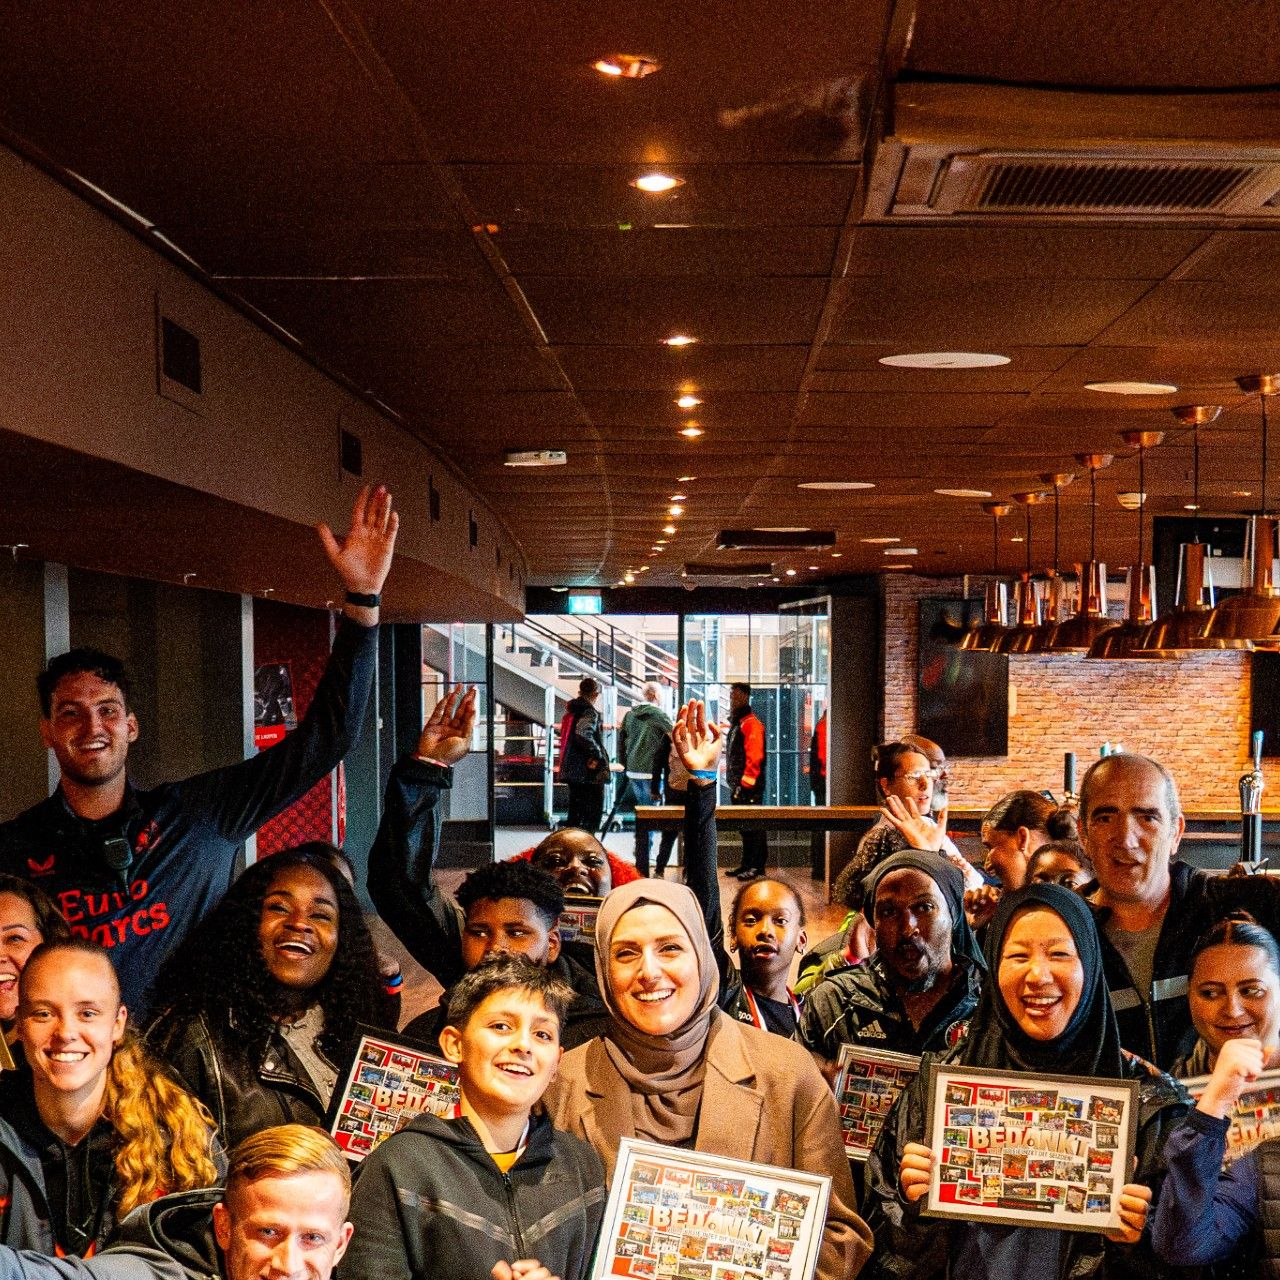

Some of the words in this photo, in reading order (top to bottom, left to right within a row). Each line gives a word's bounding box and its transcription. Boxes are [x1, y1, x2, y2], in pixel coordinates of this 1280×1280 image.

[57, 880, 149, 922] Euro
[857, 1031, 887, 1039] adidas
[970, 1126, 1088, 1157] BEDANKT
[651, 1206, 768, 1246] BEDANKT
